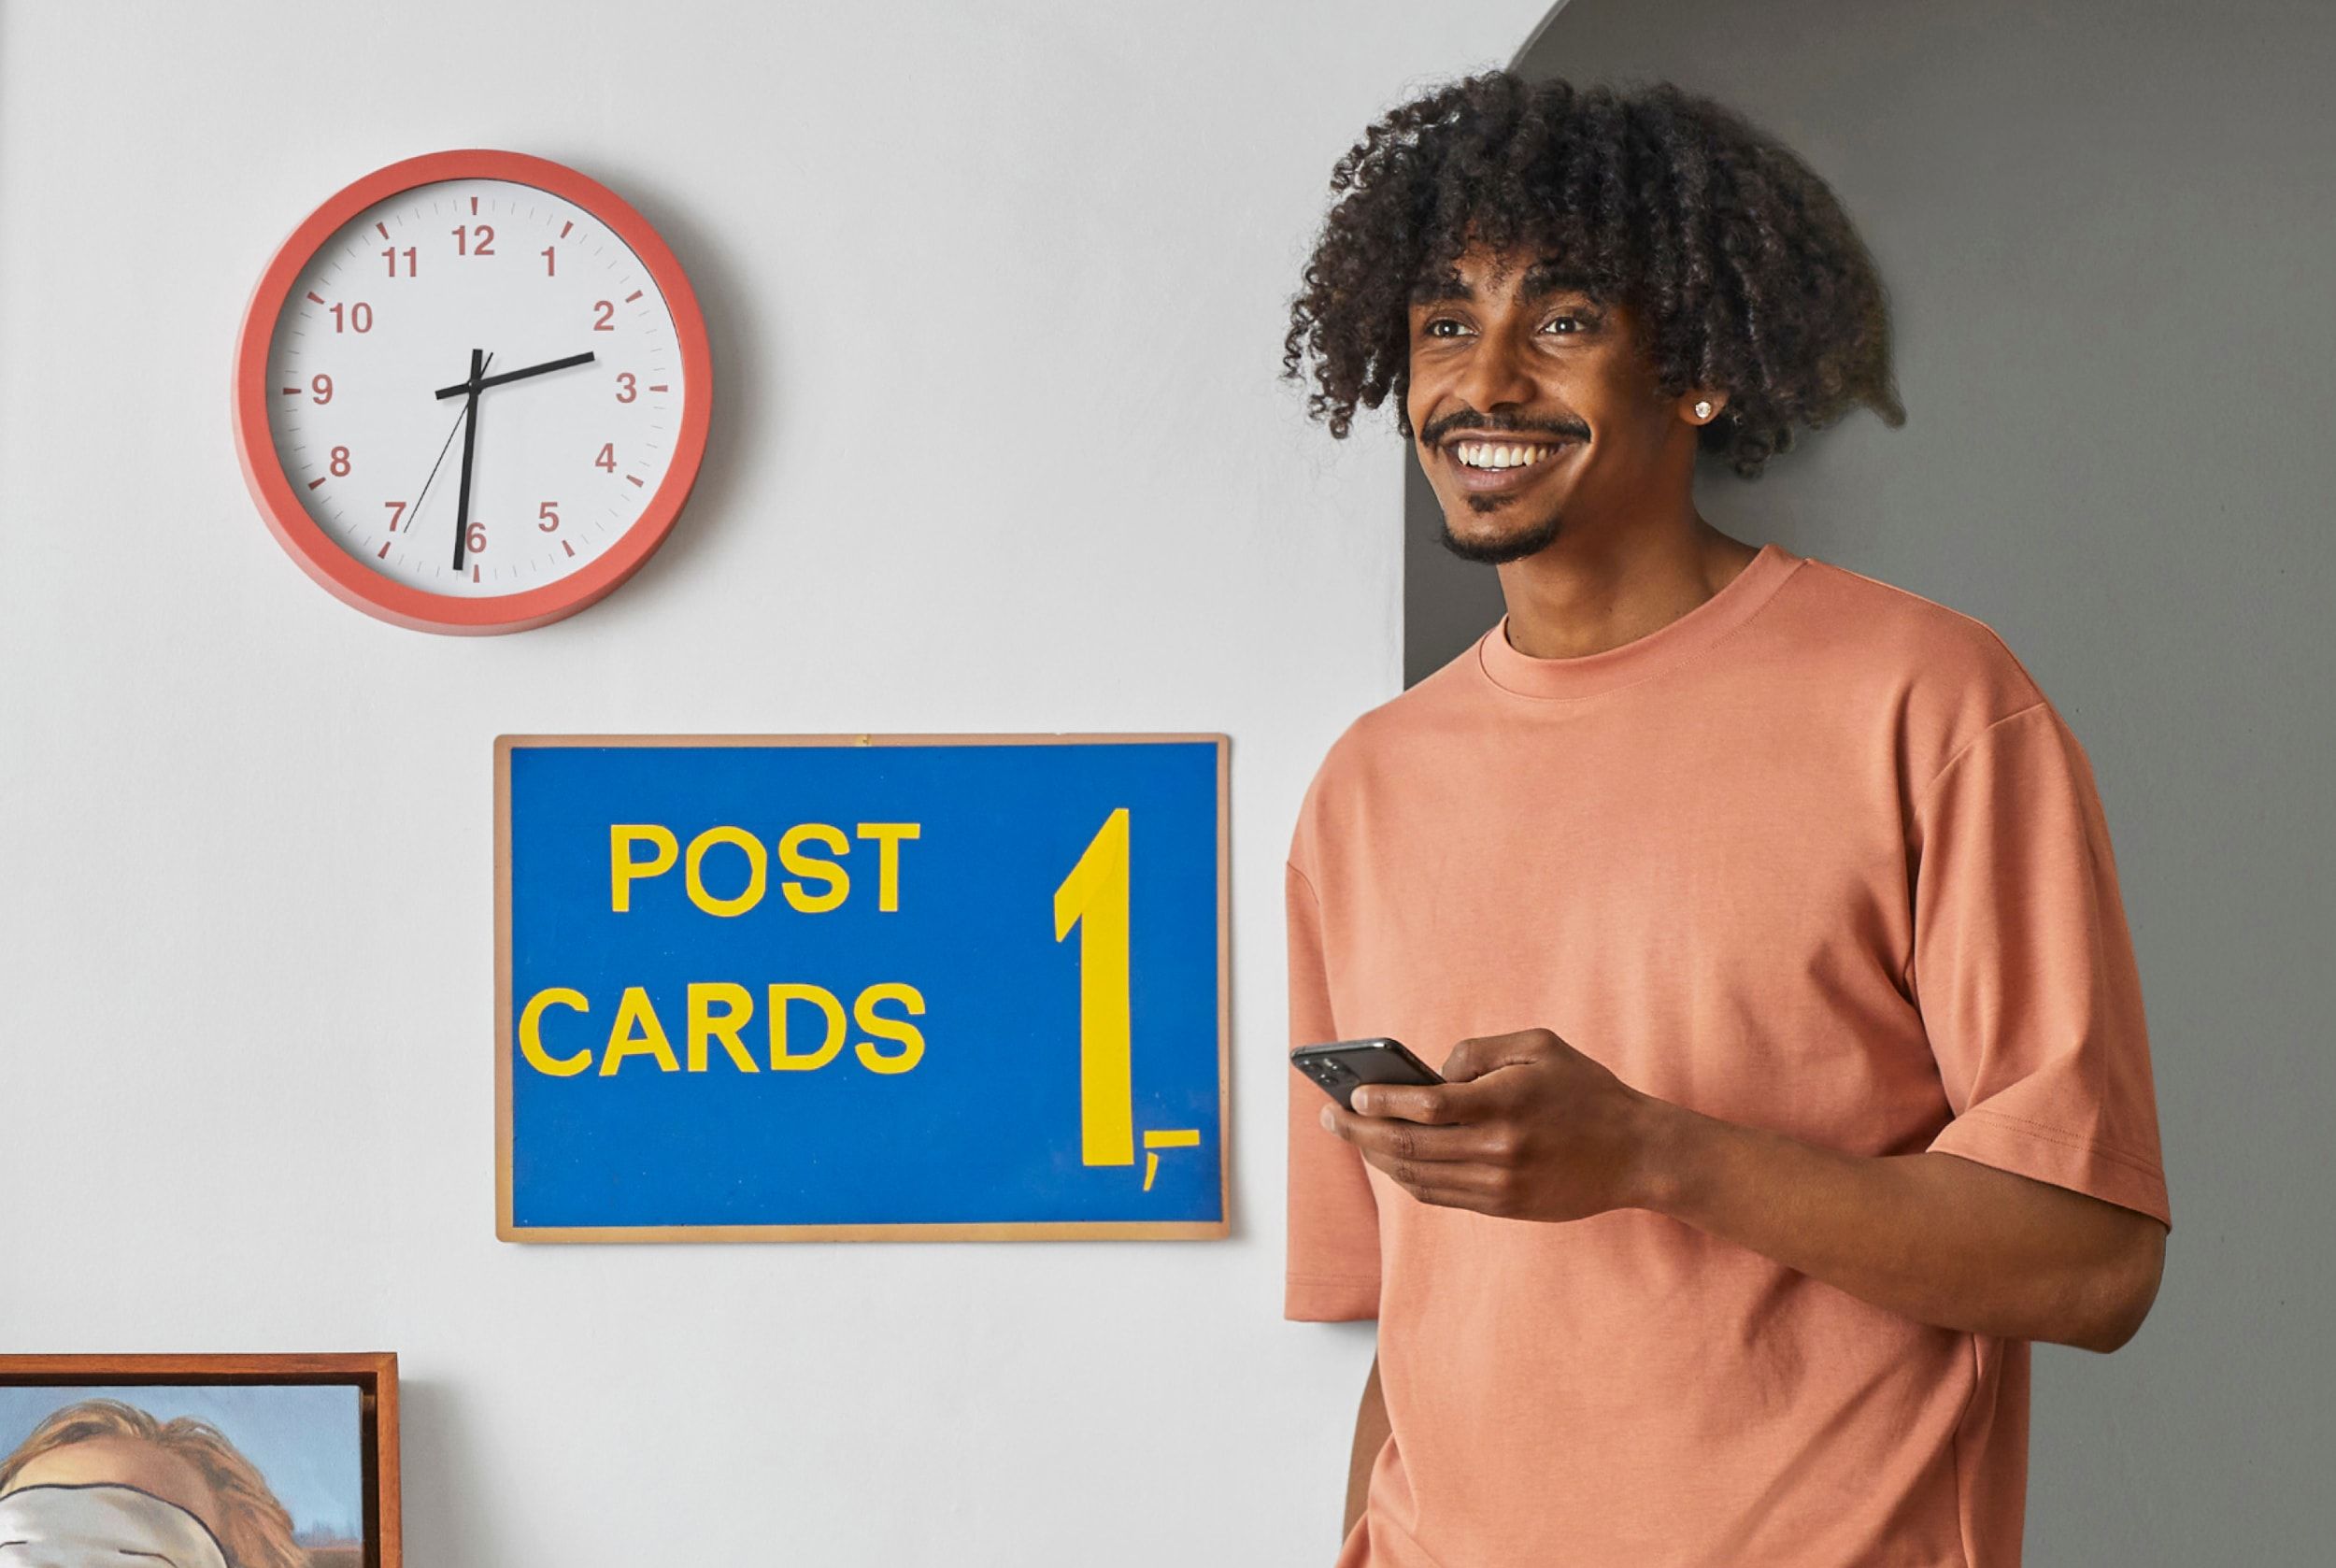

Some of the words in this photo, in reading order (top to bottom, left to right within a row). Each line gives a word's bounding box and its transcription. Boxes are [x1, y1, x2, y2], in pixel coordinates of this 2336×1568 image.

[452, 225, 495, 255] 12
[381, 247, 418, 278] 11
[541, 247, 555, 277] 1
[330, 302, 374, 334] 10
[593, 300, 615, 331] 2
[311, 374, 334, 405] 9
[616, 372, 637, 403] 3
[330, 445, 351, 478] 8
[594, 443, 617, 473] 4
[384, 501, 407, 532] 7
[538, 501, 560, 532] 5
[466, 521, 487, 553] 6
[609, 822, 921, 917] POST
[518, 981, 926, 1077] CARDS
